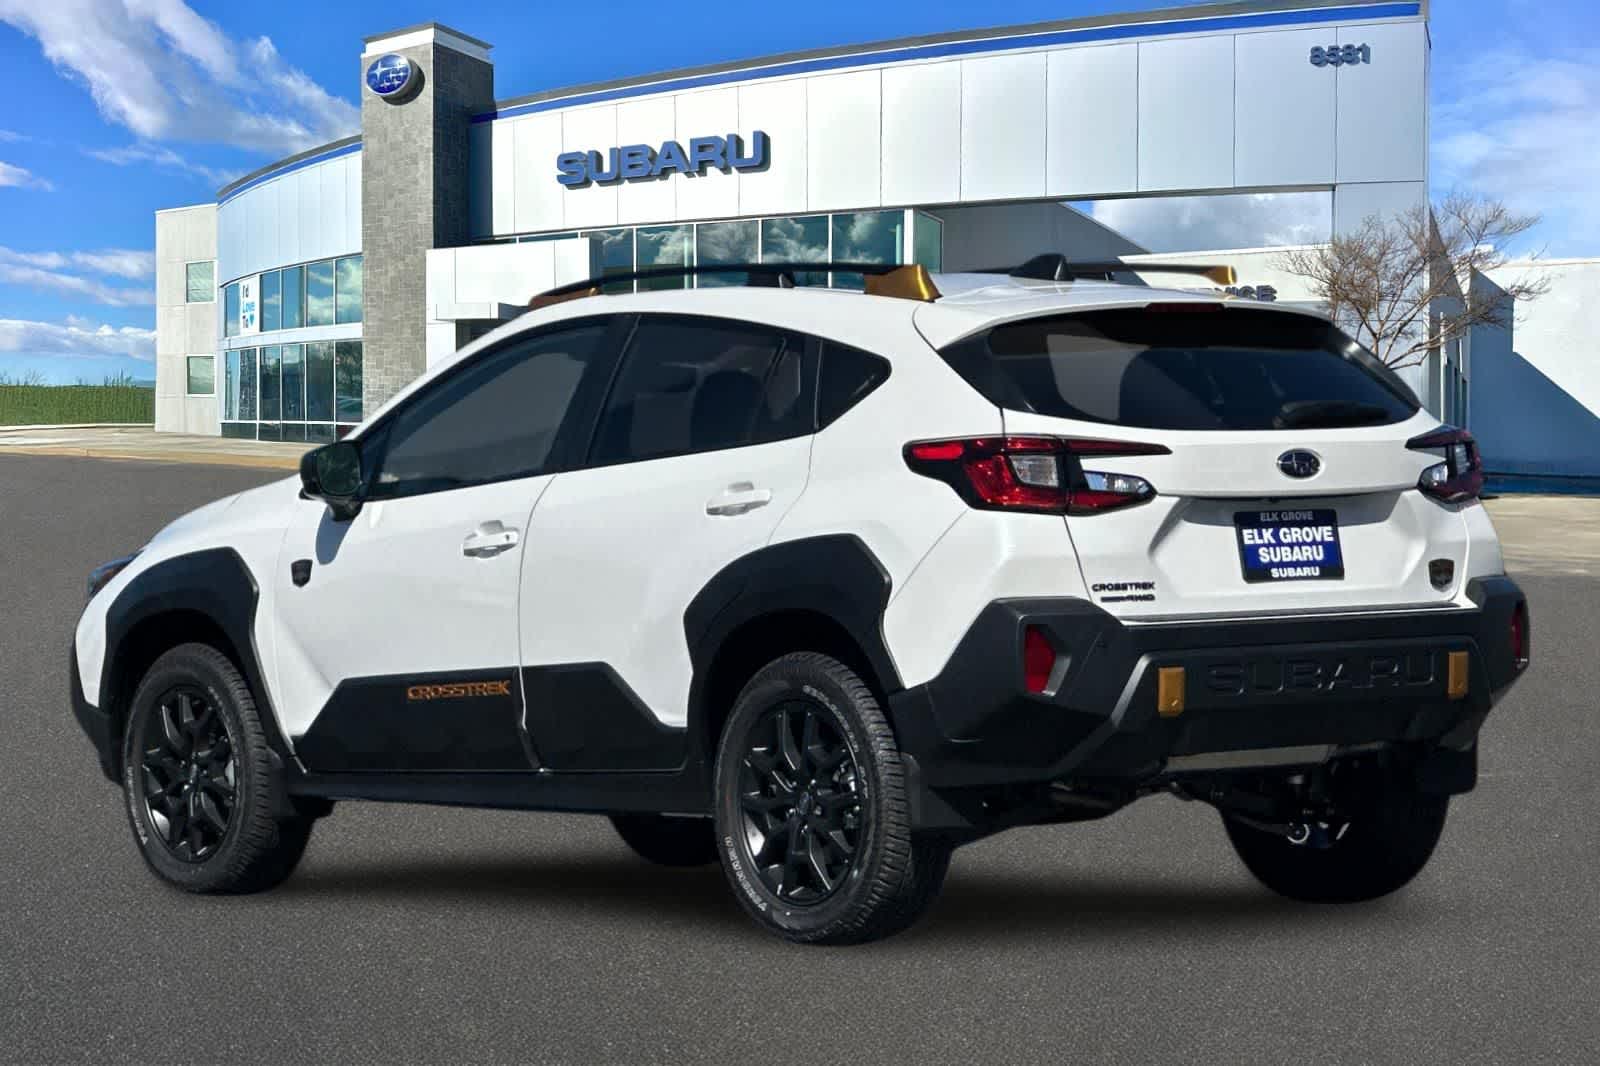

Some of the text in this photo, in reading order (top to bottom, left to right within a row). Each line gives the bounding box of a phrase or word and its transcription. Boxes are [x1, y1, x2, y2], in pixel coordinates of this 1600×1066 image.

[556, 130, 771, 190] SUBARU
[1260, 510, 1314, 522] ELK GROVE
[1242, 526, 1334, 545] ELK GROVE
[1258, 545, 1324, 563] SUBARU
[1270, 566, 1320, 578] SUBARU
[1091, 581, 1155, 593] CROSSTREK
[1207, 652, 1437, 697] SUBARU
[406, 680, 511, 700] CROSSTREK
